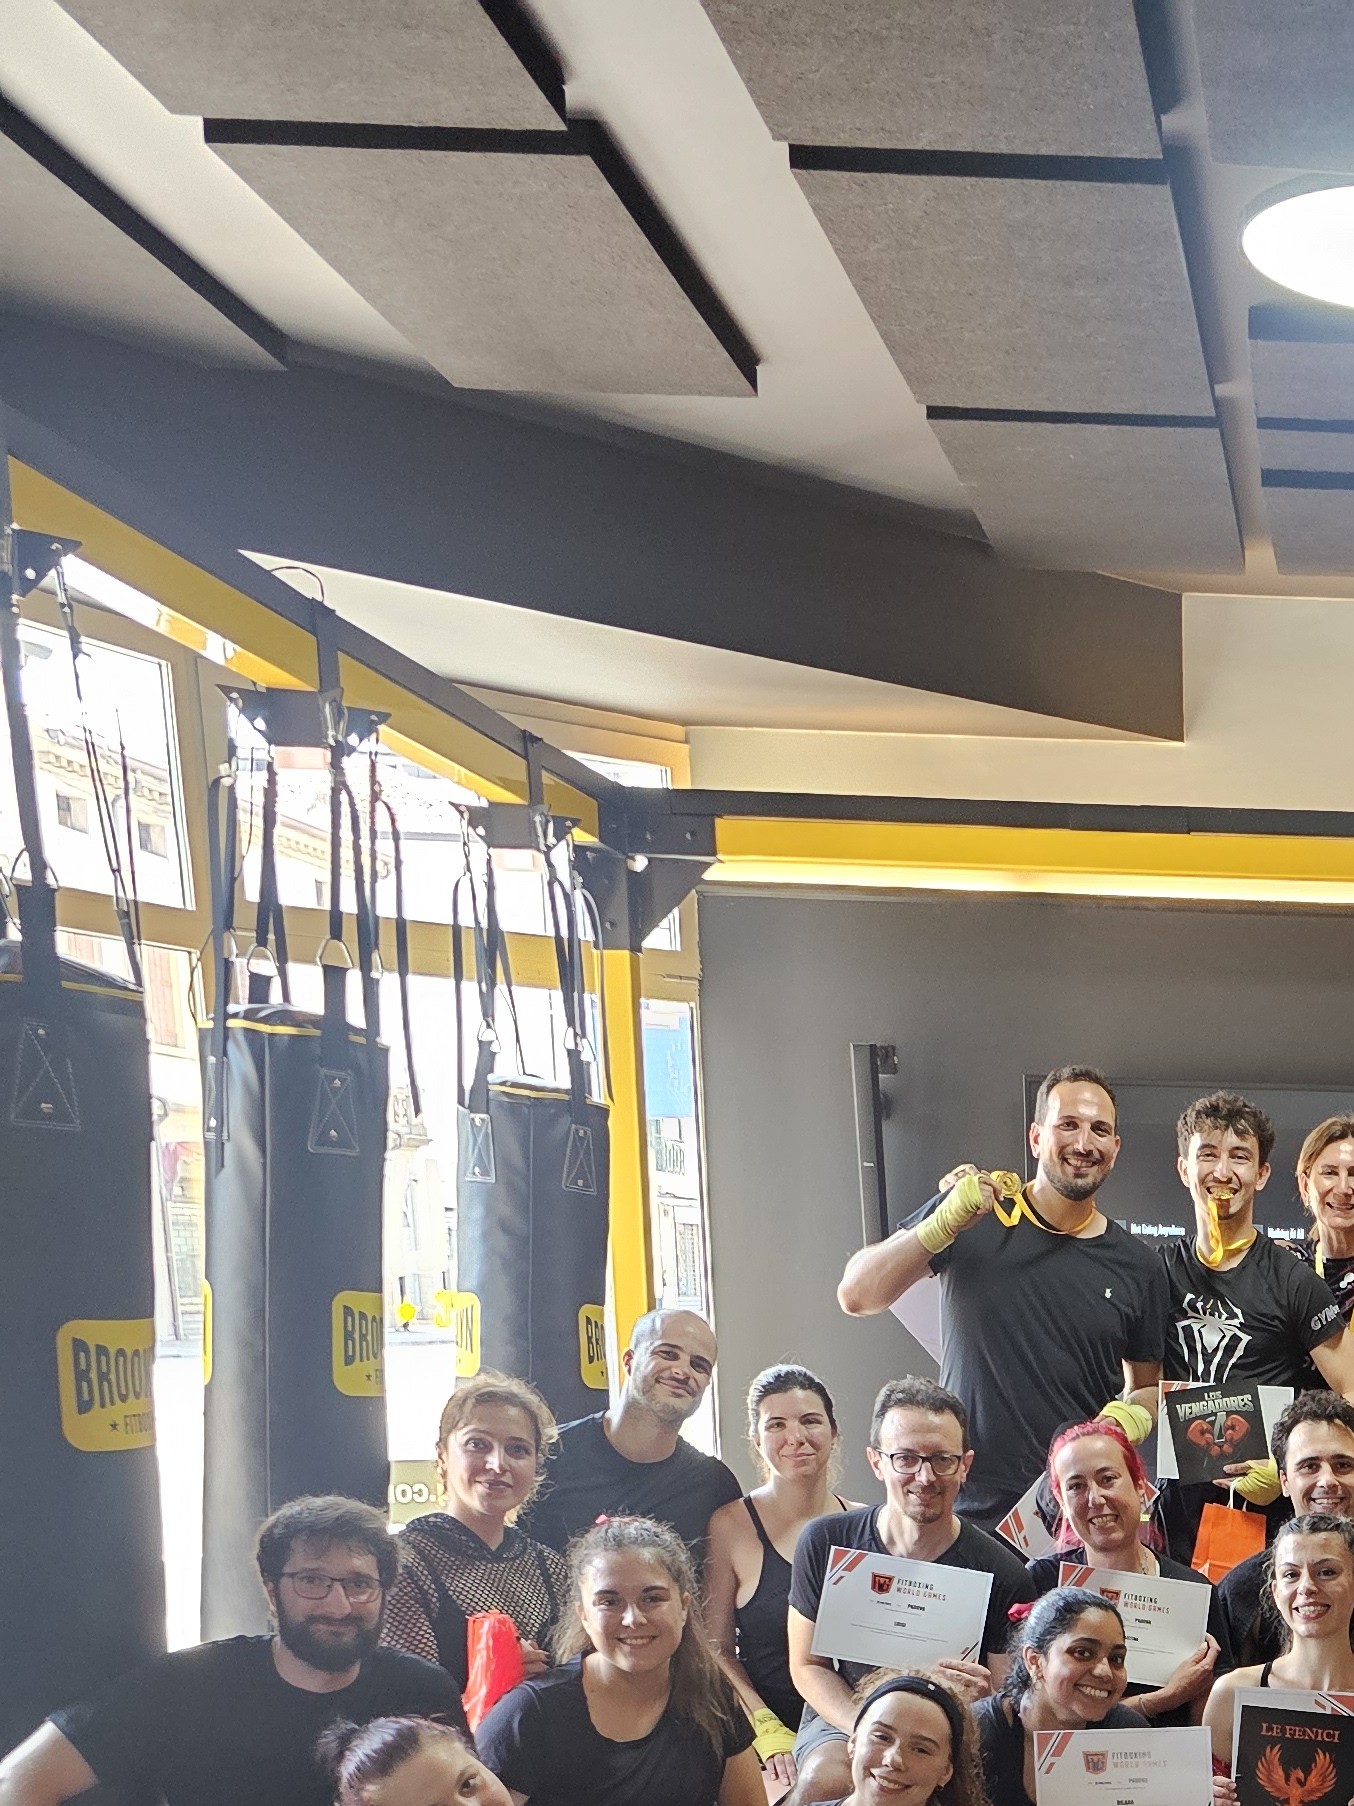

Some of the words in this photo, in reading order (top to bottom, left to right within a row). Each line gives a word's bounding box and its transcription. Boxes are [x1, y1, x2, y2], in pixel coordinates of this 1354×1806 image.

[1204, 1391, 1223, 1401] LOS
[1176, 1394, 1255, 1422] VENGADORES
[897, 1577, 934, 1591] FITBOXING
[896, 1586, 921, 1597] WORLD
[923, 1592, 946, 1601] GAMES
[1124, 1592, 1158, 1604] FITBOXING
[1123, 1601, 1146, 1611] WORLD
[1148, 1605, 1170, 1614] GAMES
[1260, 1722, 1282, 1736] LE
[1284, 1725, 1340, 1743] FENICI
